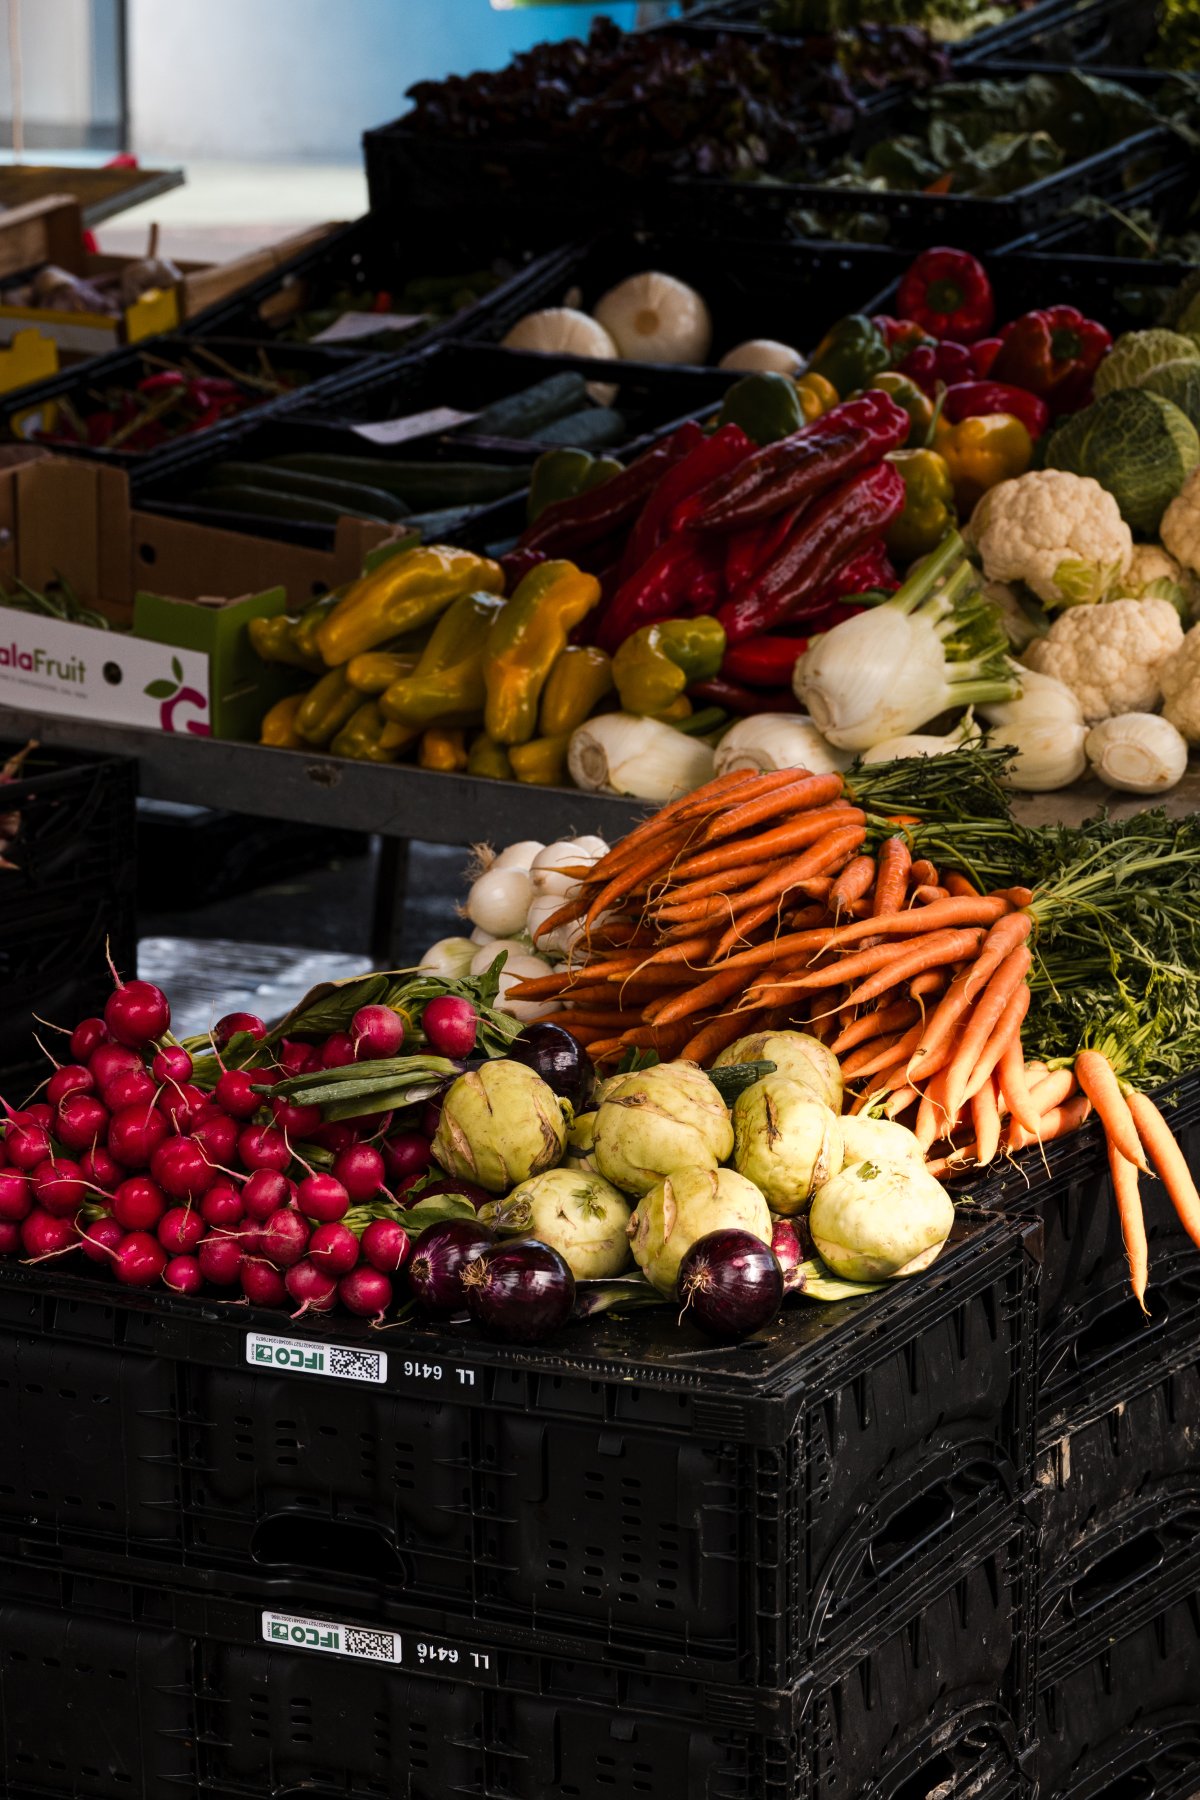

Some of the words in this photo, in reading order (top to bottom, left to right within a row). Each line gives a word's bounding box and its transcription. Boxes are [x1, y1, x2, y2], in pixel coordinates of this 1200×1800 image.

[275, 1347, 324, 1371] IFCO
[404, 1361, 442, 1380] 6416
[455, 1368, 475, 1386] LL
[290, 1626, 340, 1650] IFCO
[416, 1643, 458, 1663] 6416
[469, 1652, 489, 1670] LL
